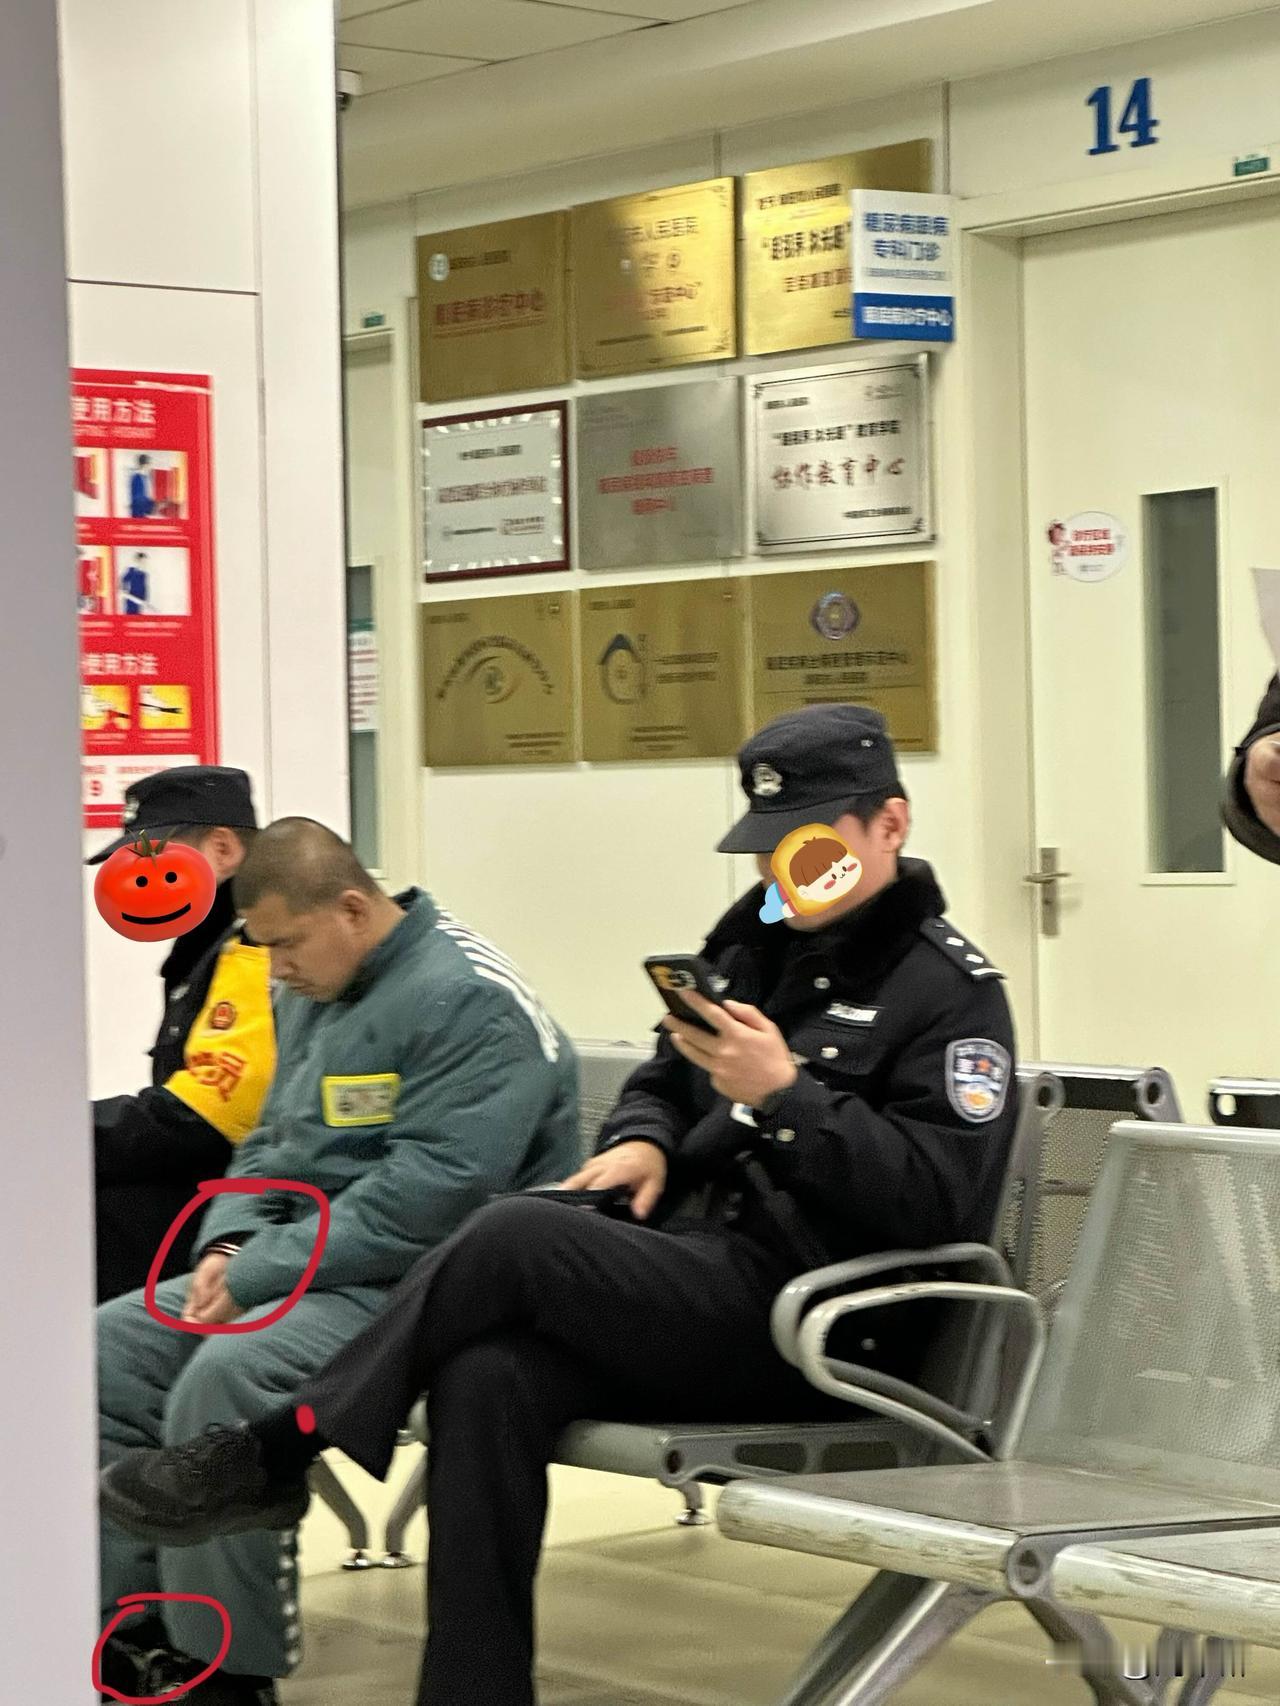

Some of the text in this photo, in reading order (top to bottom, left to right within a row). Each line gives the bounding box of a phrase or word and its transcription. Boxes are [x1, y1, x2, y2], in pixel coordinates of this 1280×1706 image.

[1085, 77, 1160, 155] 14
[872, 240, 942, 261] 专科门诊
